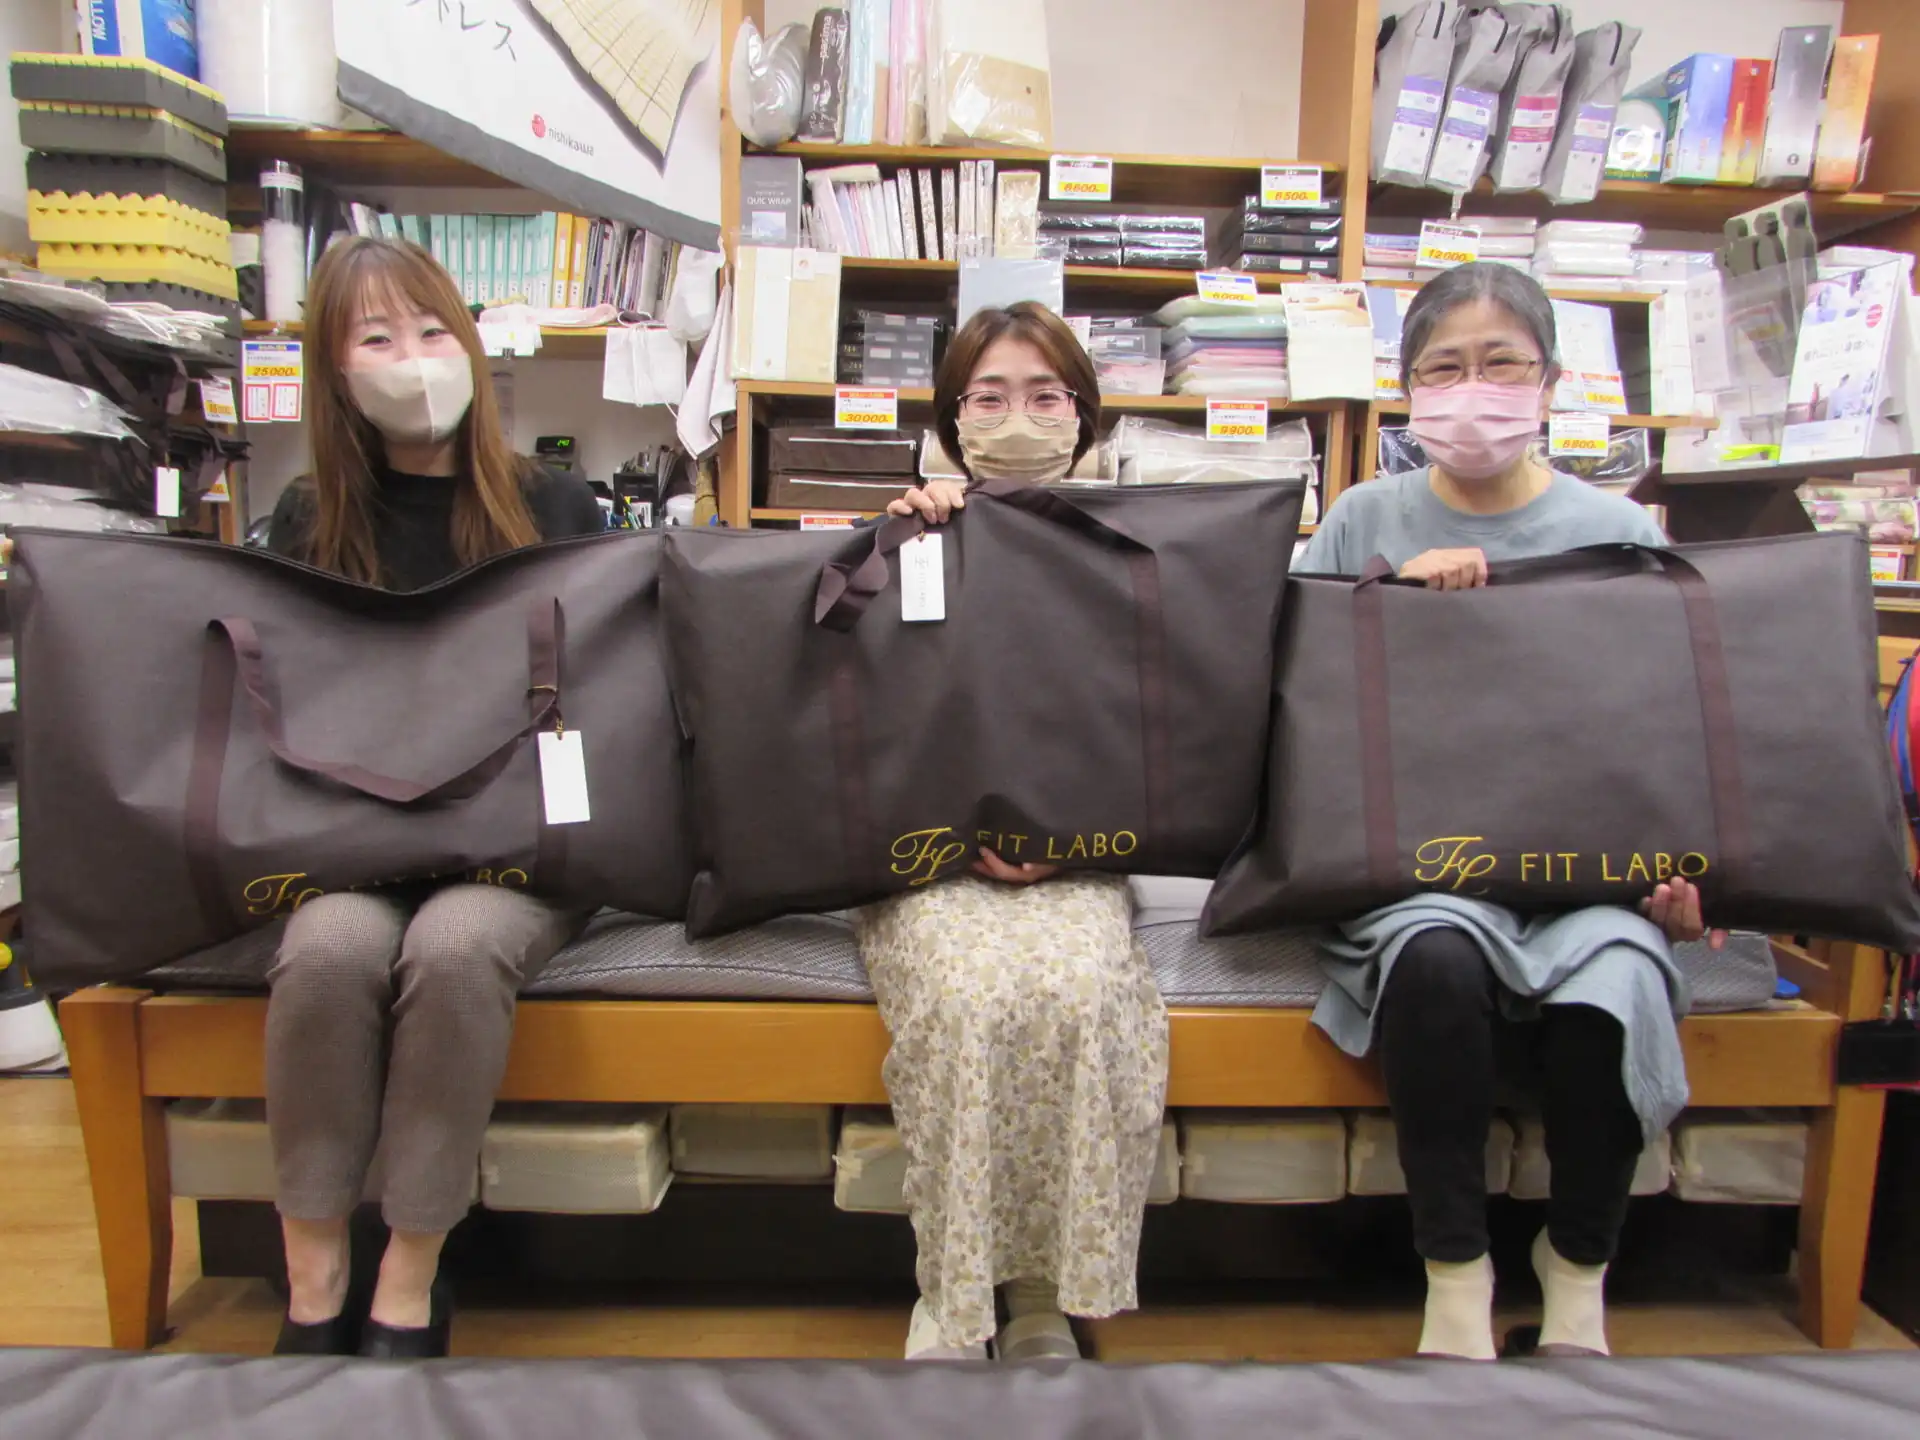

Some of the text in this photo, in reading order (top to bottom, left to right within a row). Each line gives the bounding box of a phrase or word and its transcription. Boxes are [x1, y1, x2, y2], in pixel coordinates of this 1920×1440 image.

[405, 0, 517, 61] トレス
[547, 126, 595, 157] nishikawa
[768, 197, 792, 205] WRAP
[976, 831, 1028, 855] FIT
[1046, 830, 1137, 859] LABO
[1520, 853, 1579, 882] FIT
[1602, 852, 1708, 882] LABO
